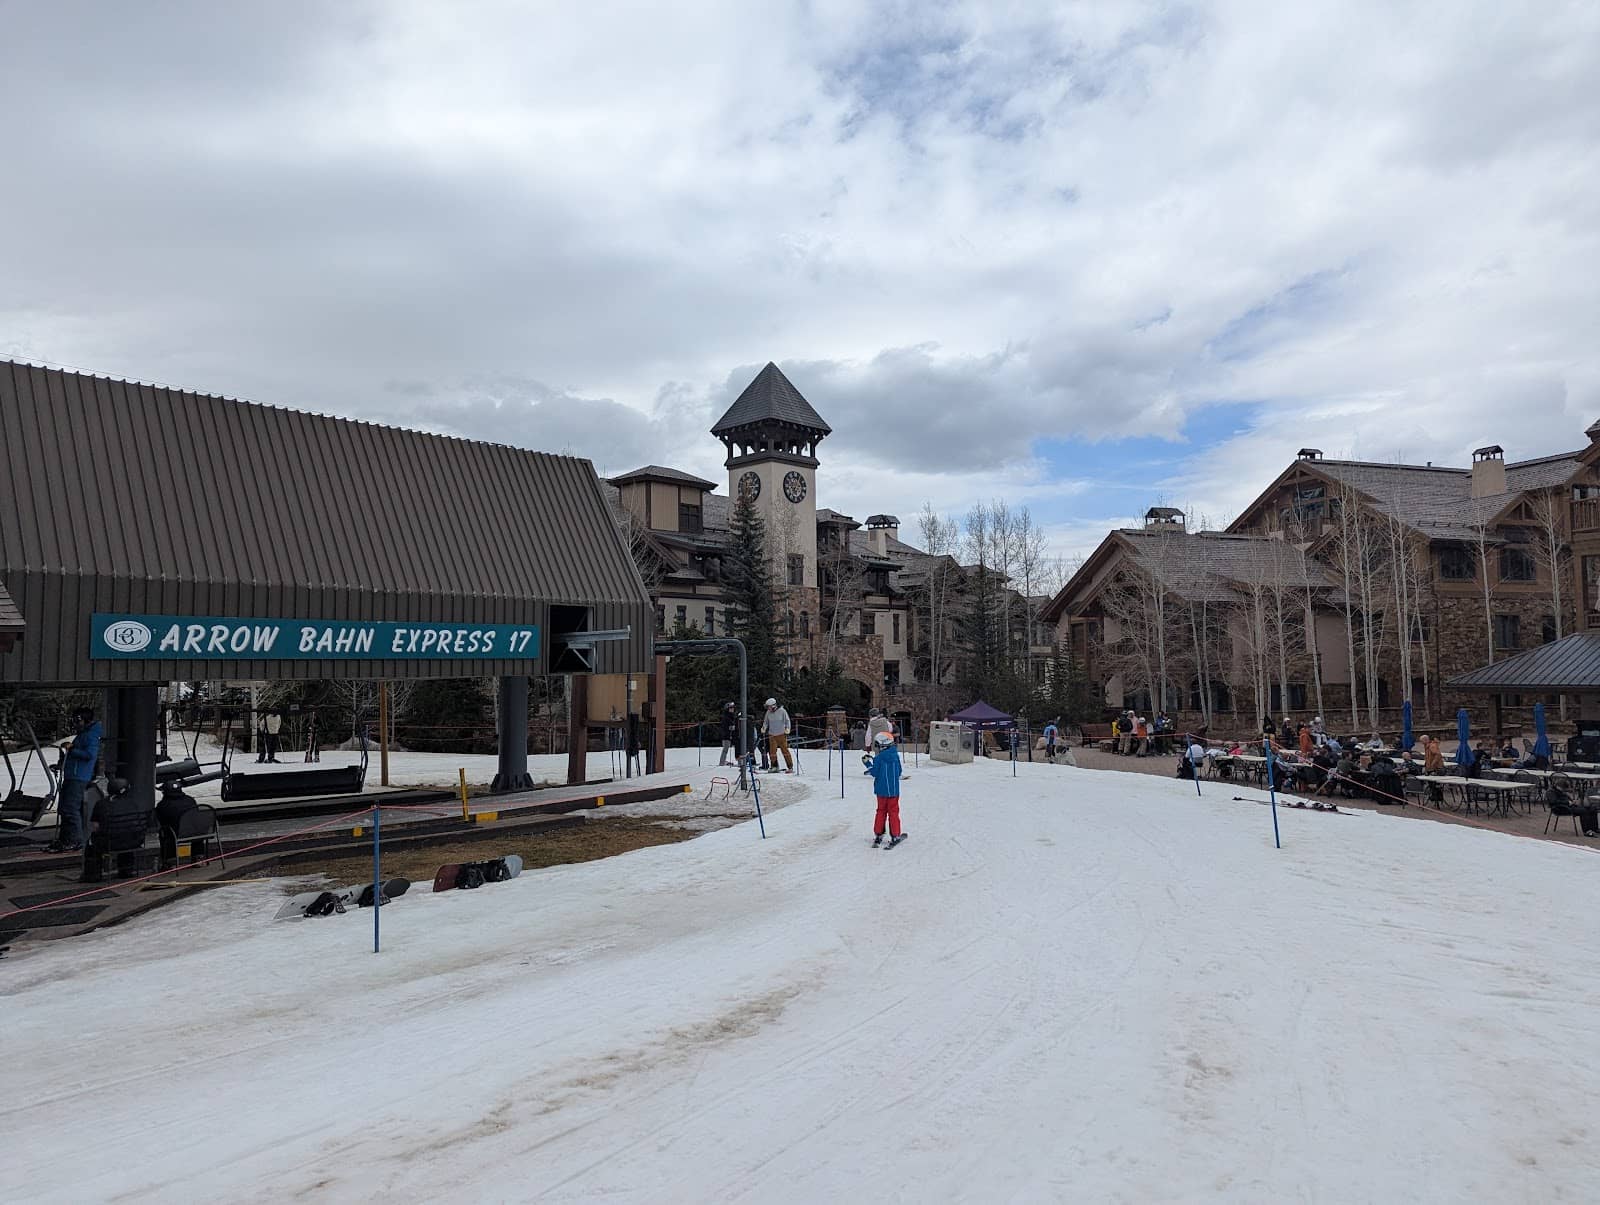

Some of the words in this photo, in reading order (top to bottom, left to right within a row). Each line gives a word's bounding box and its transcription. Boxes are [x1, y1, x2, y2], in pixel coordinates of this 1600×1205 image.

[159, 623, 280, 653] ARROW
[298, 626, 375, 653] BAHN
[391, 628, 496, 654] EXPRESS
[509, 631, 533, 653] 17
